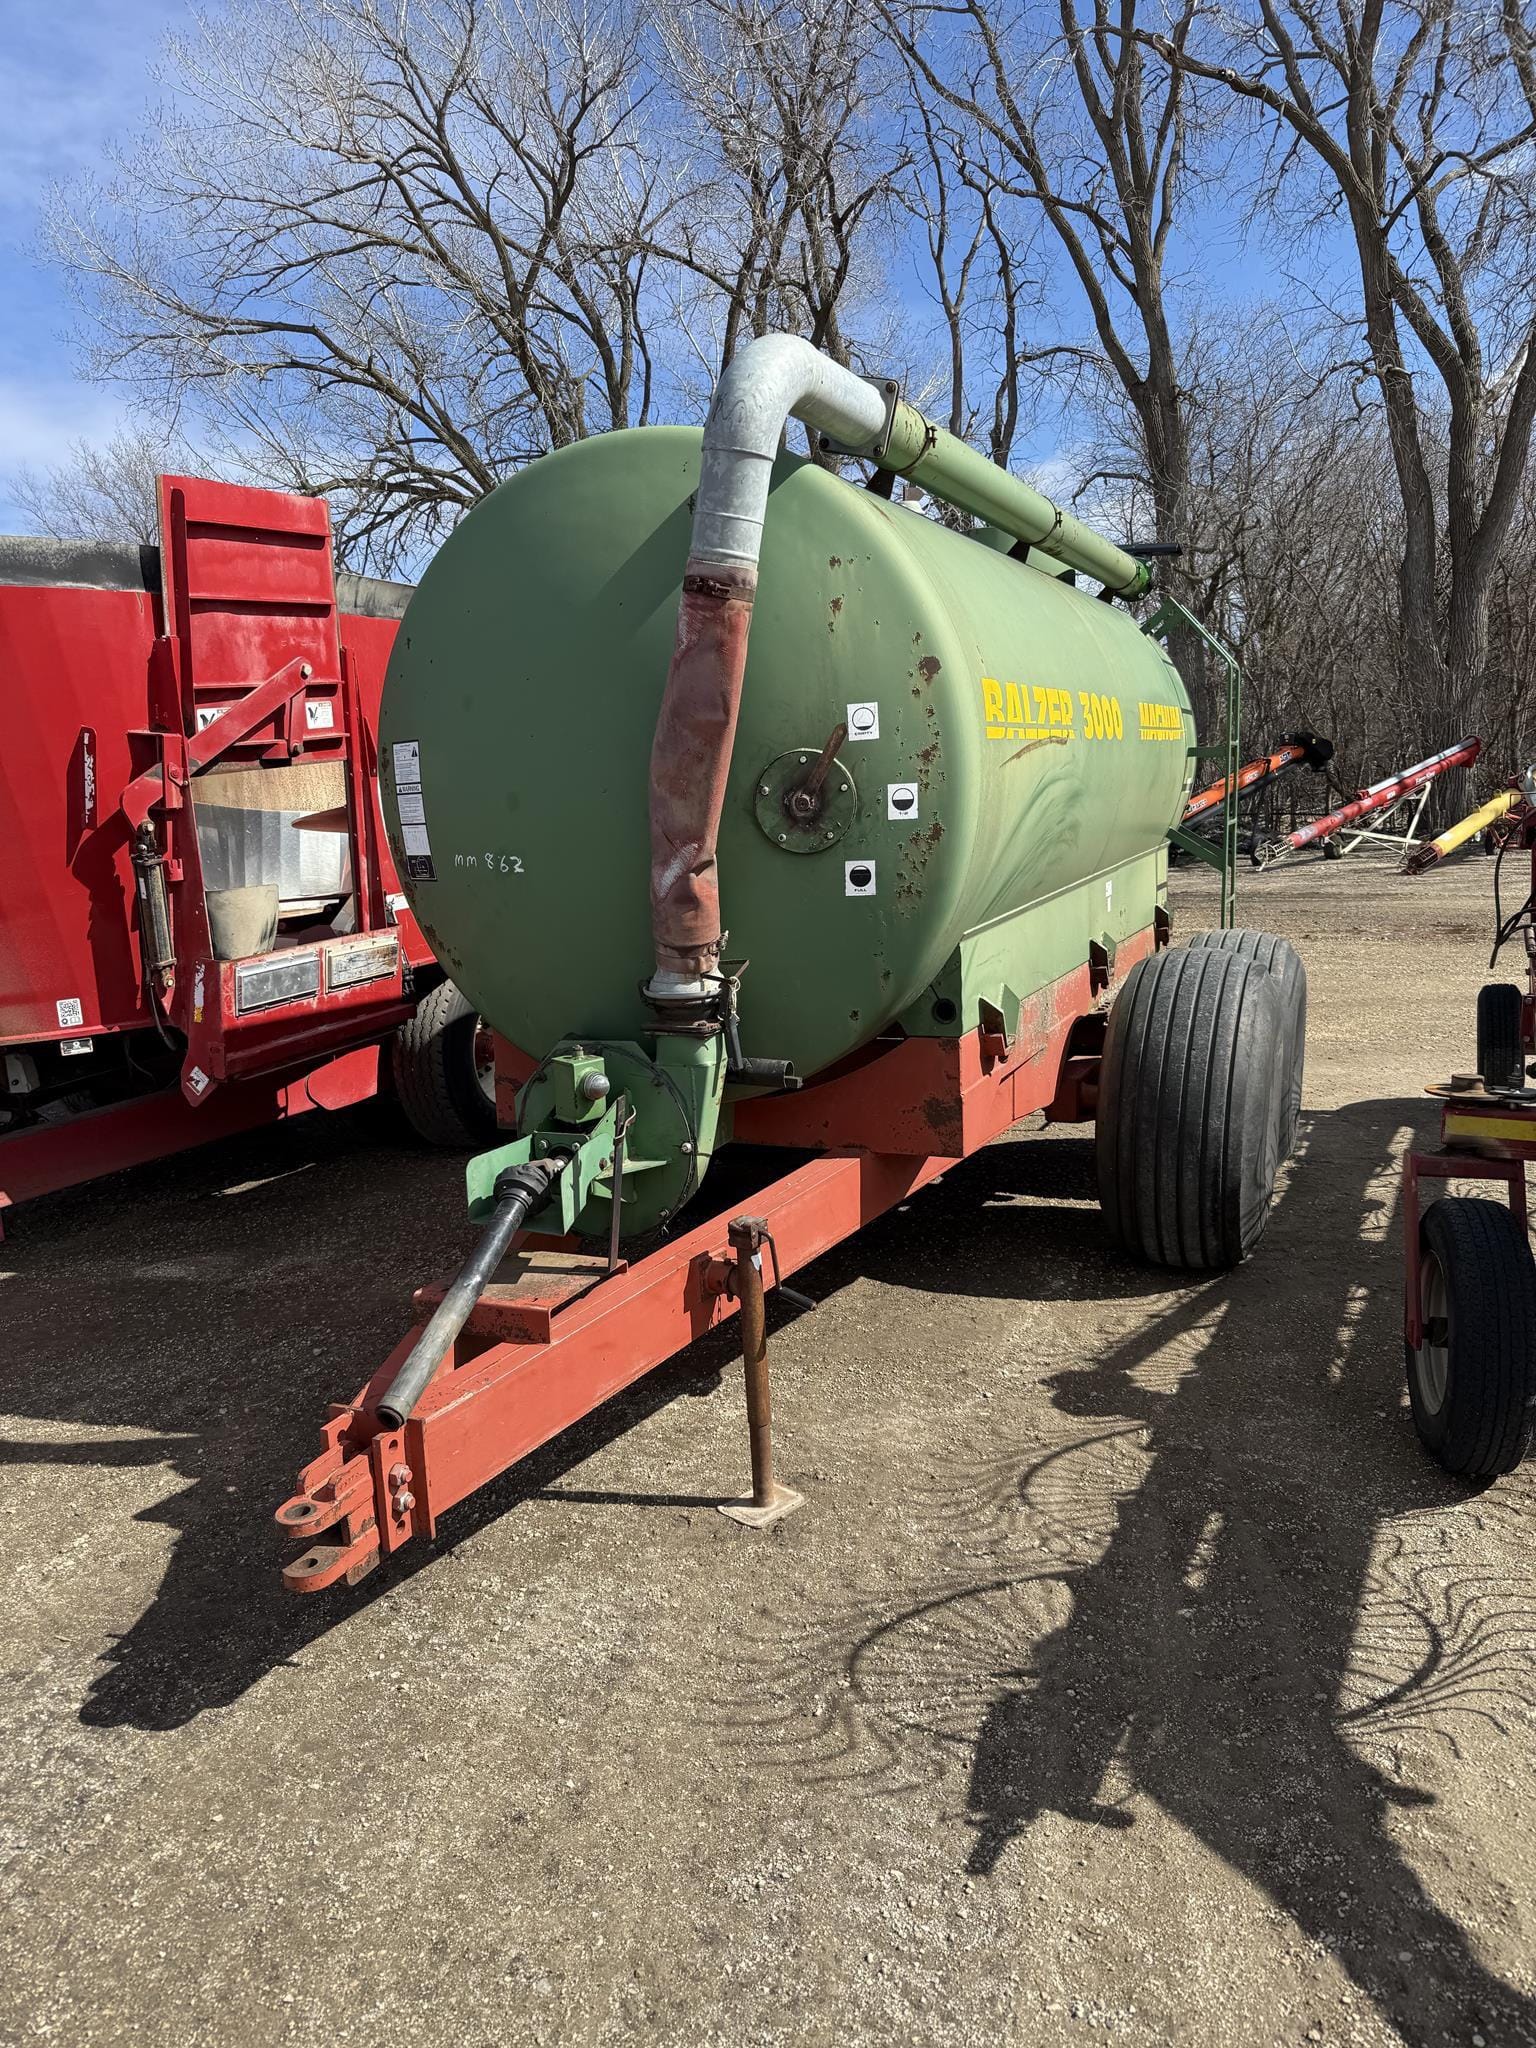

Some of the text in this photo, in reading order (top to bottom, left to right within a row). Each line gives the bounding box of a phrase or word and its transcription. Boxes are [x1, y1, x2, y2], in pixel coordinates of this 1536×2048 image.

[980, 677, 1123, 740] BALZER 3000
[485, 852, 525, 873] 862
